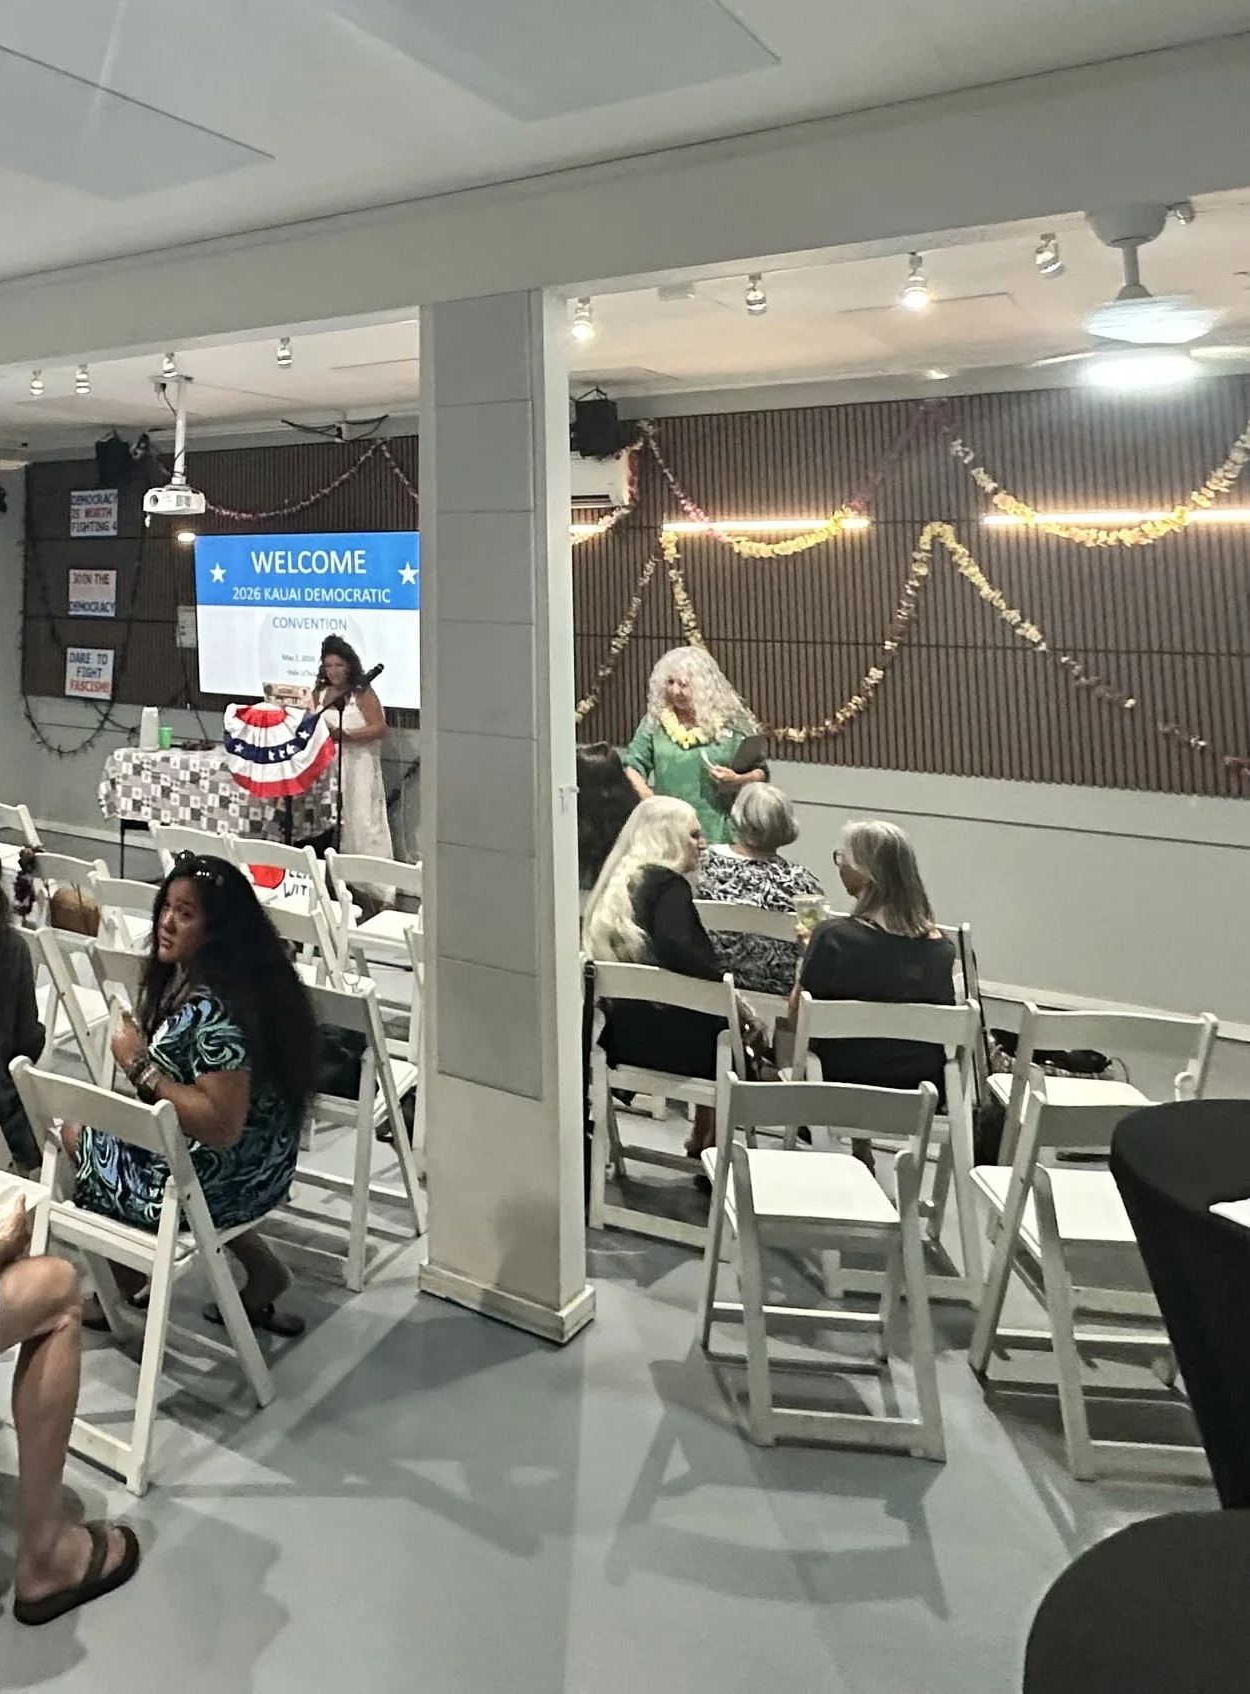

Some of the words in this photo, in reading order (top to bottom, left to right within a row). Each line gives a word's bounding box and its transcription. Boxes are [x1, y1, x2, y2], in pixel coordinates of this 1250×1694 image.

[250, 550, 367, 575] WELCOME
[94, 572, 110, 585] THE
[232, 587, 261, 601] 2026
[264, 587, 301, 602] KAUAI
[304, 587, 391, 604] DEMOCRATIC
[69, 601, 116, 613] DEMOCRACY
[272, 616, 347, 631] CONVENTION
[69, 653, 91, 664] DARE
[96, 653, 108, 665] TO
[77, 666, 103, 678] FIGHT
[284, 881, 308, 898] WIT
